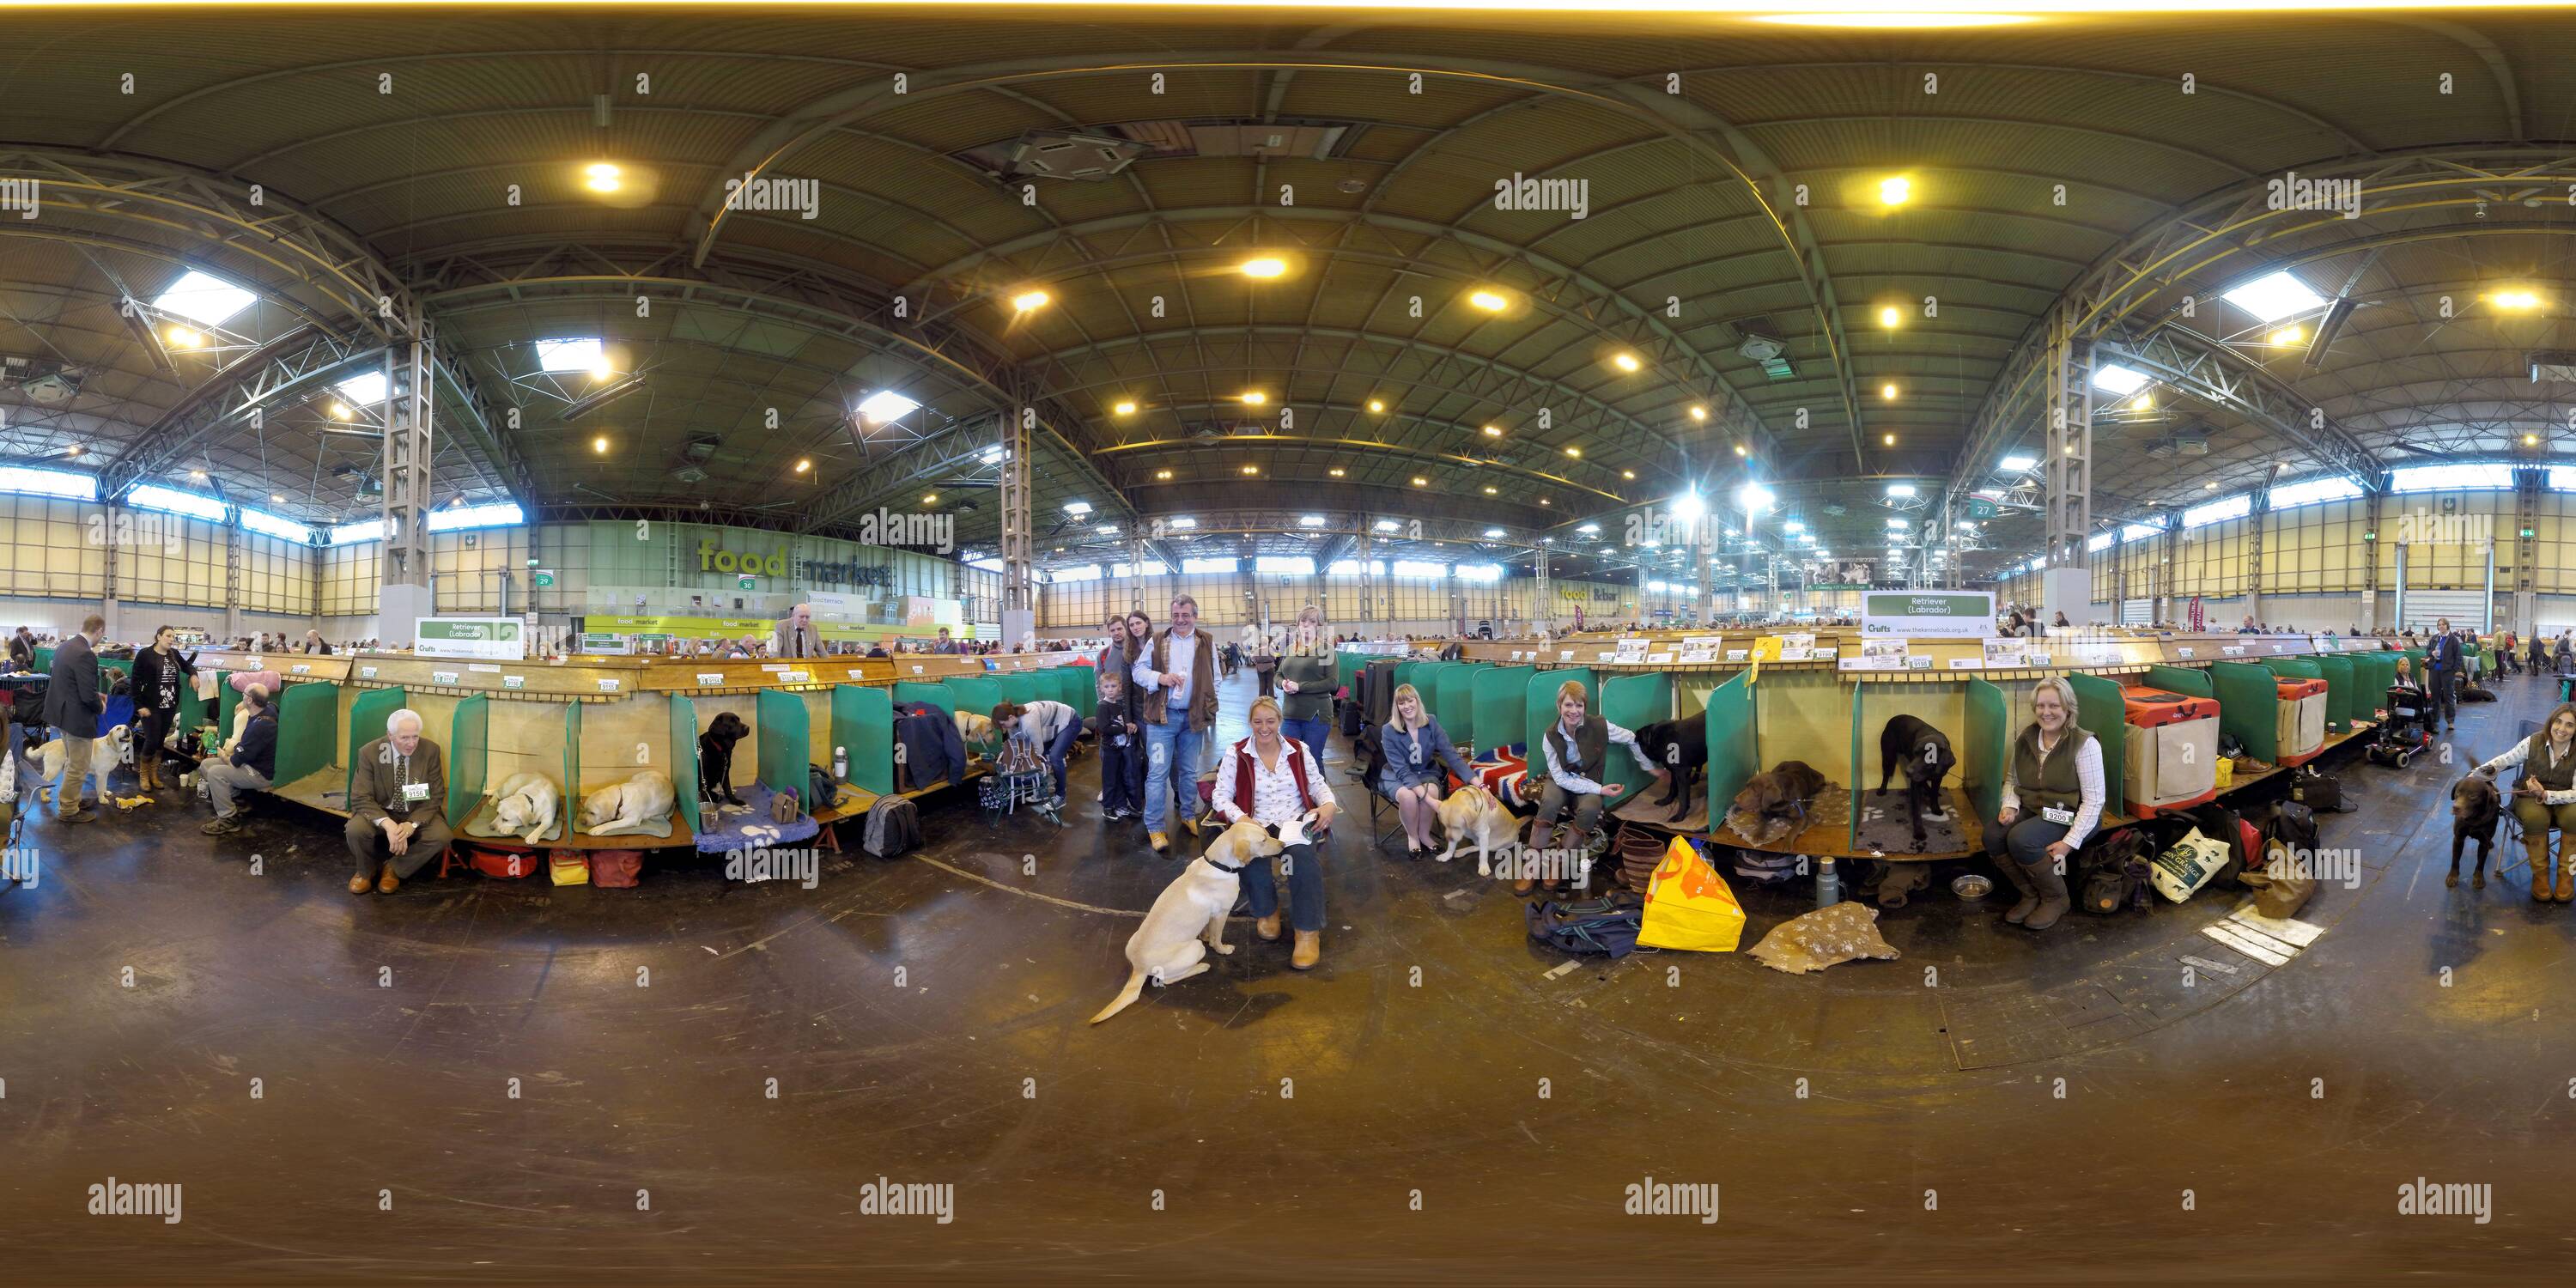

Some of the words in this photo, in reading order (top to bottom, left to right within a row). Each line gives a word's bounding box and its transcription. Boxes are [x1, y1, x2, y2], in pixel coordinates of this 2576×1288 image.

[1978, 506, 1990, 515] 27
[698, 538, 787, 577] food
[803, 556, 890, 586] market
[1561, 588, 1588, 600] food
[1868, 624, 1890, 633] Crufts
[2049, 812, 2067, 821] 9200
[2175, 857, 2200, 878] GRANGE
